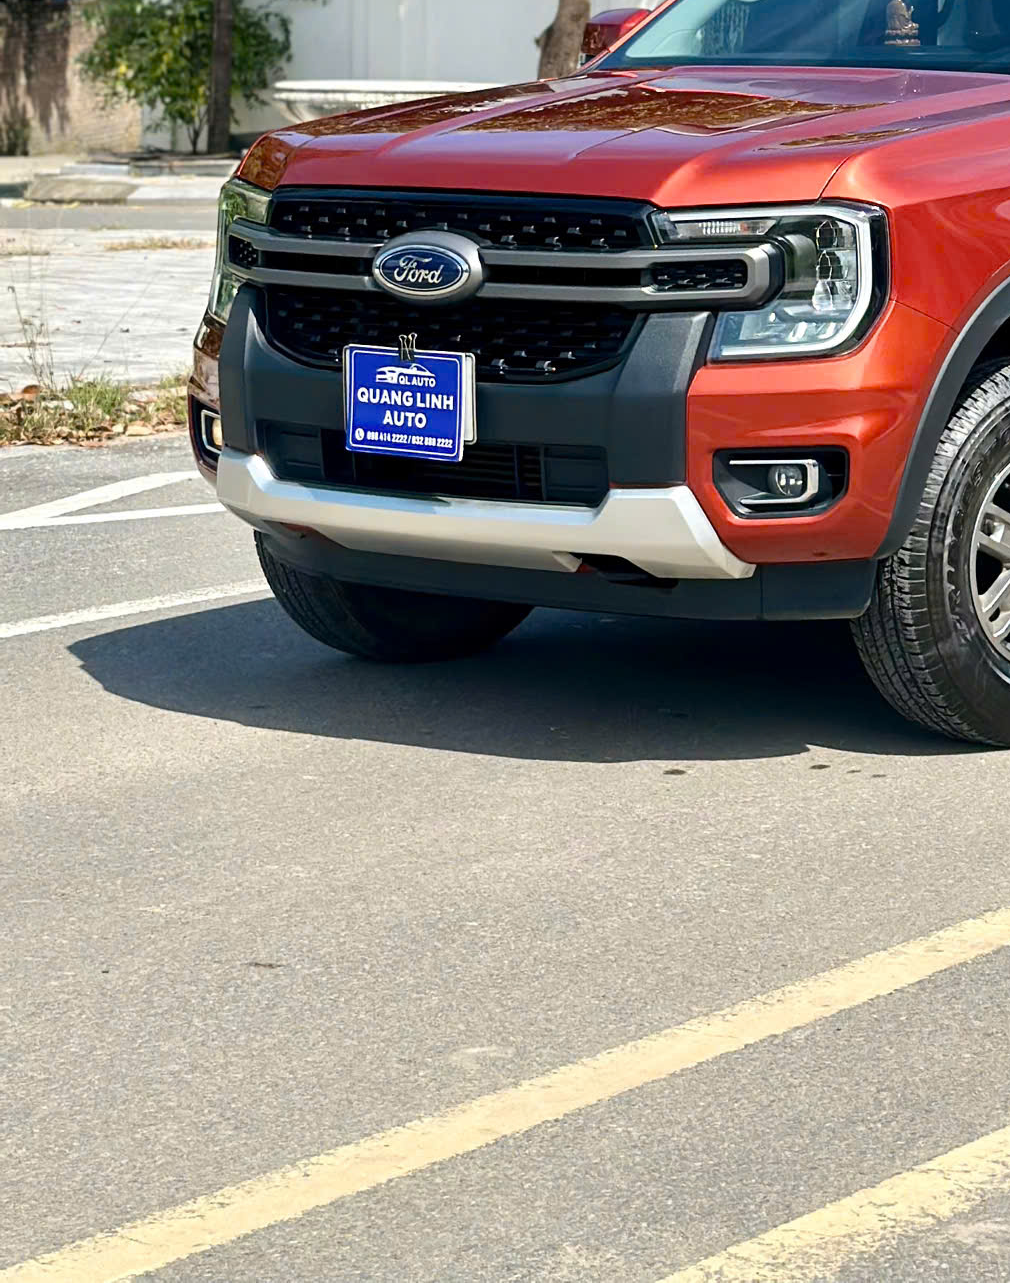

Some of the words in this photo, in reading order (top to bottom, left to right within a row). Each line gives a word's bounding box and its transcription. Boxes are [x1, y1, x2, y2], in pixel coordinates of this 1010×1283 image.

[394, 255, 443, 284] Ford
[399, 375, 410, 386] QL
[411, 377, 436, 388] AUTO
[357, 387, 413, 407] QUANG
[416, 392, 454, 411] LINH
[383, 410, 427, 429] AUTO
[391, 433, 408, 444] 2222
[436, 437, 453, 449] 2222
